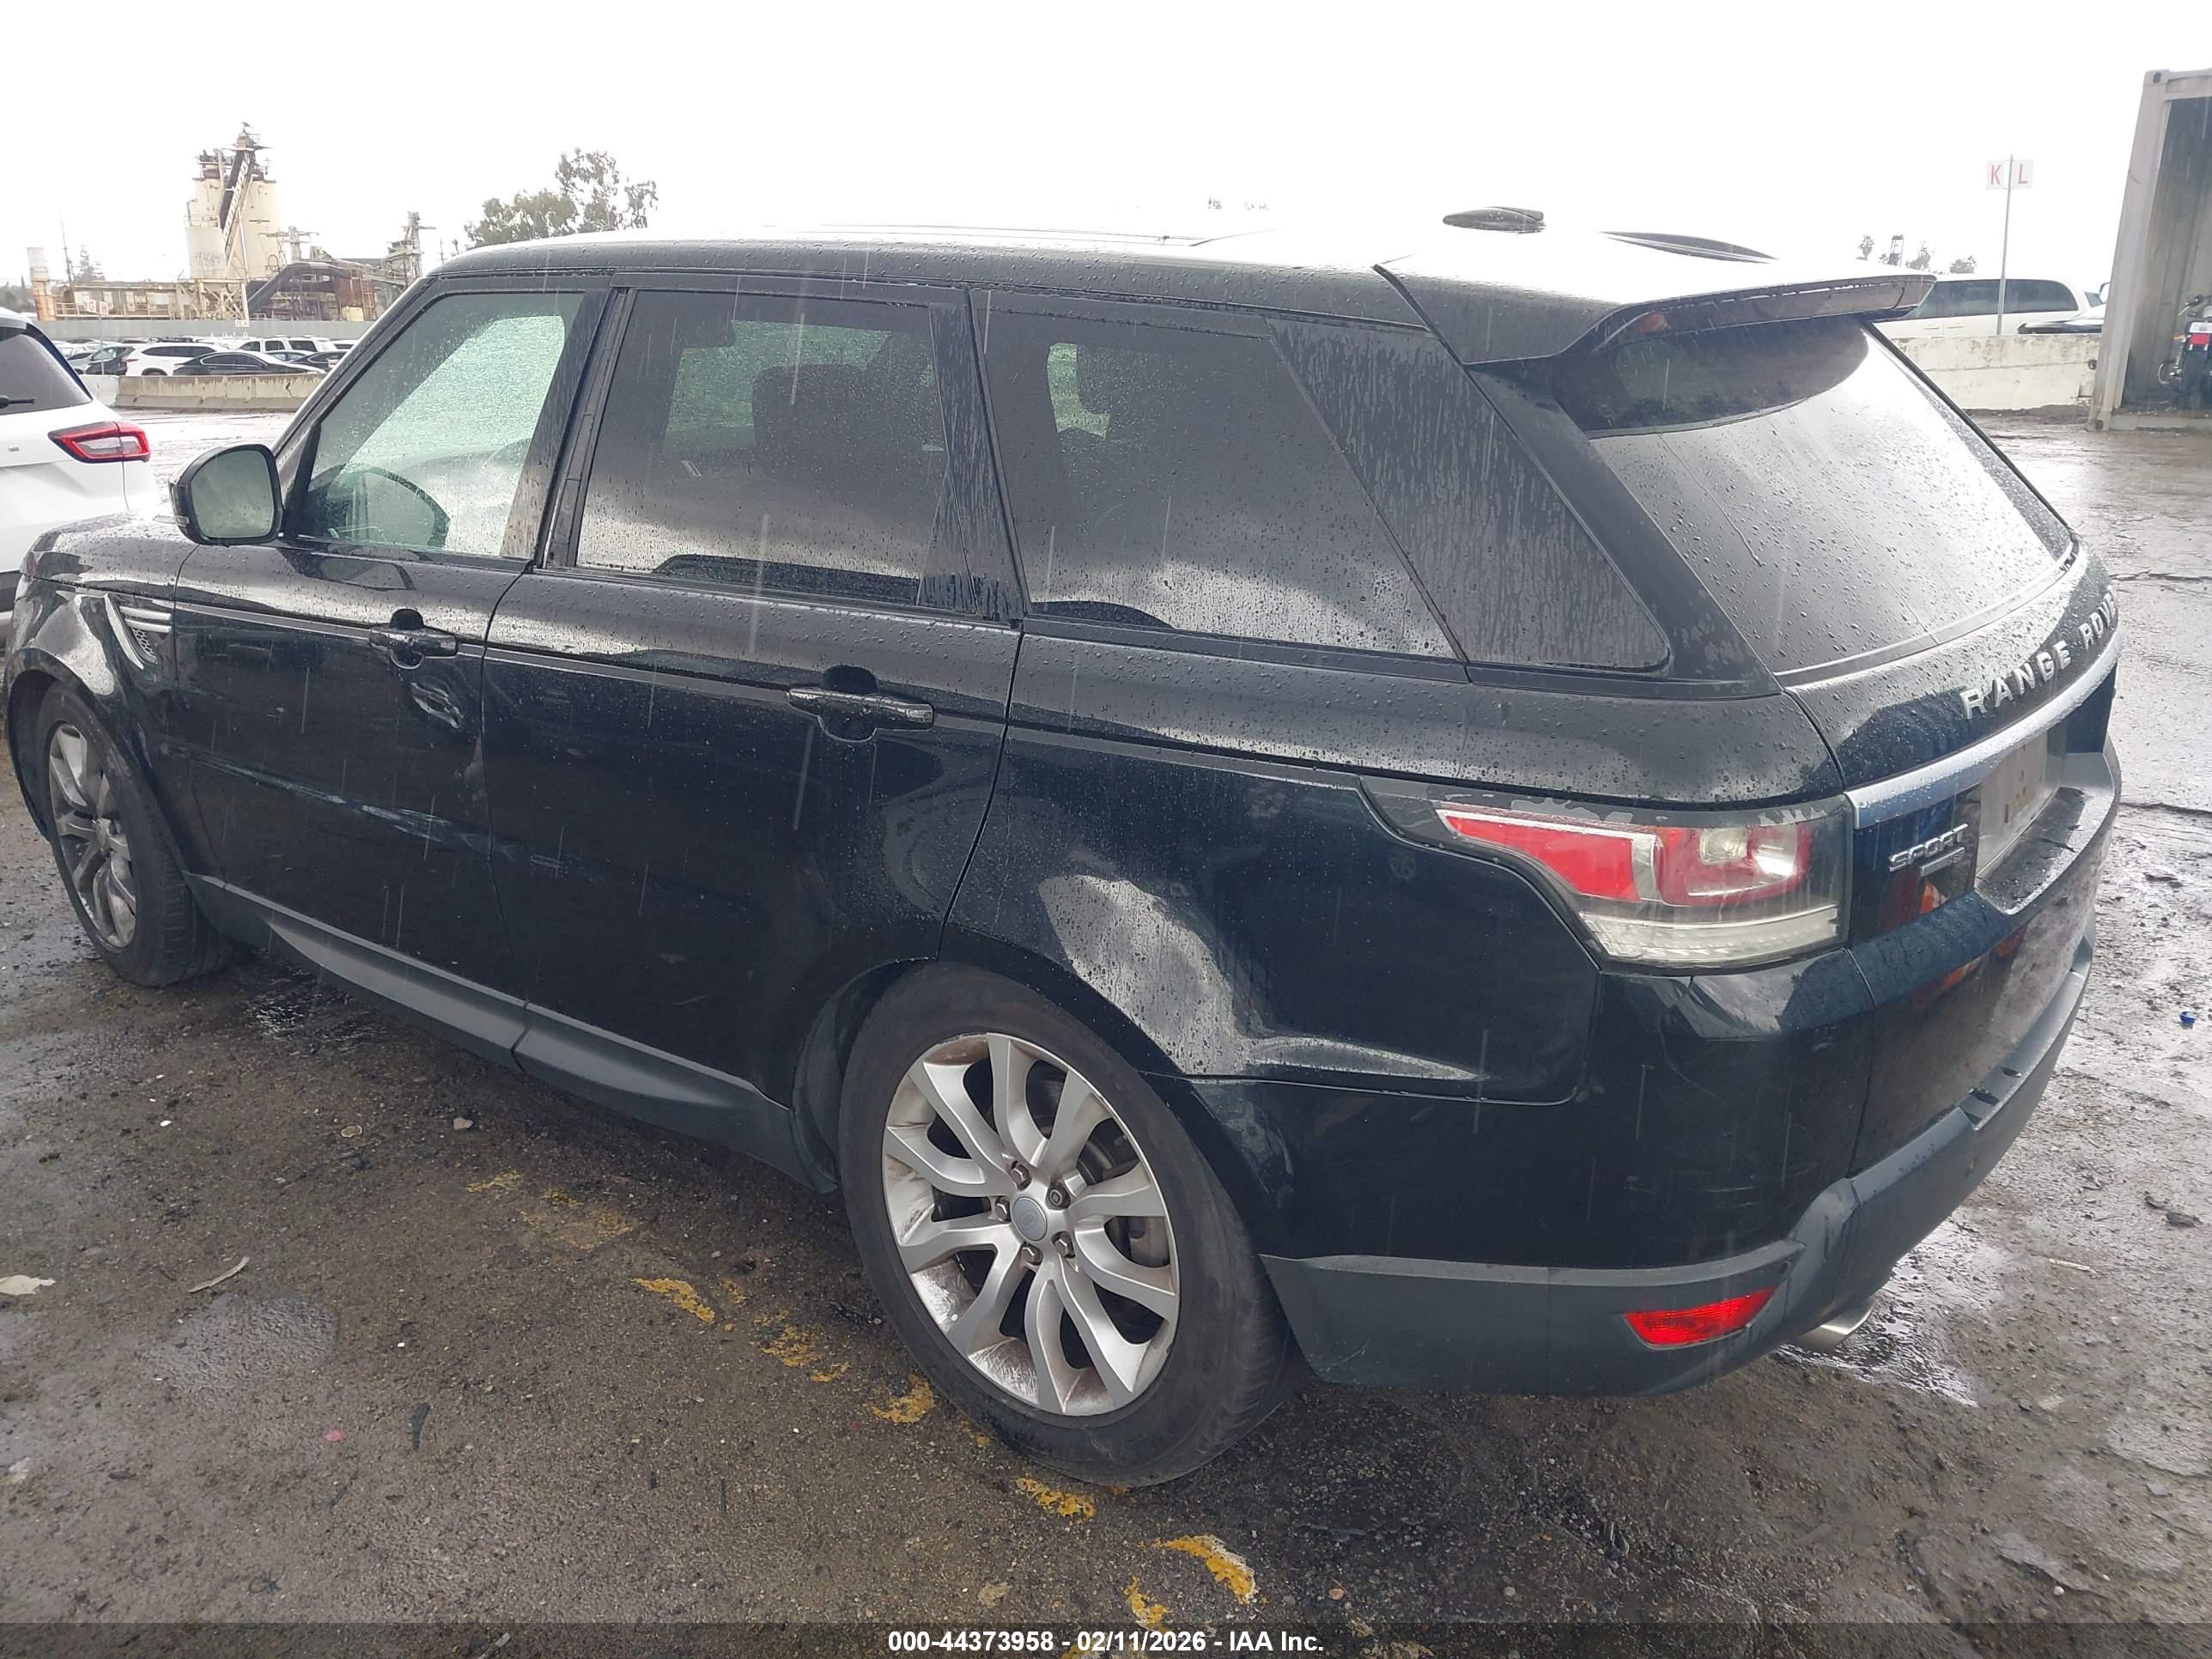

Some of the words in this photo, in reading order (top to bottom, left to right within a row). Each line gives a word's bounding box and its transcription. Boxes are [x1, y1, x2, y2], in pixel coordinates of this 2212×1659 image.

[1990, 164, 2002, 185] K
[2017, 163, 2029, 185] L
[1959, 640, 2073, 720] RANGE
[2077, 586, 2118, 651] ROVE
[1888, 823, 1969, 872] SPORT
